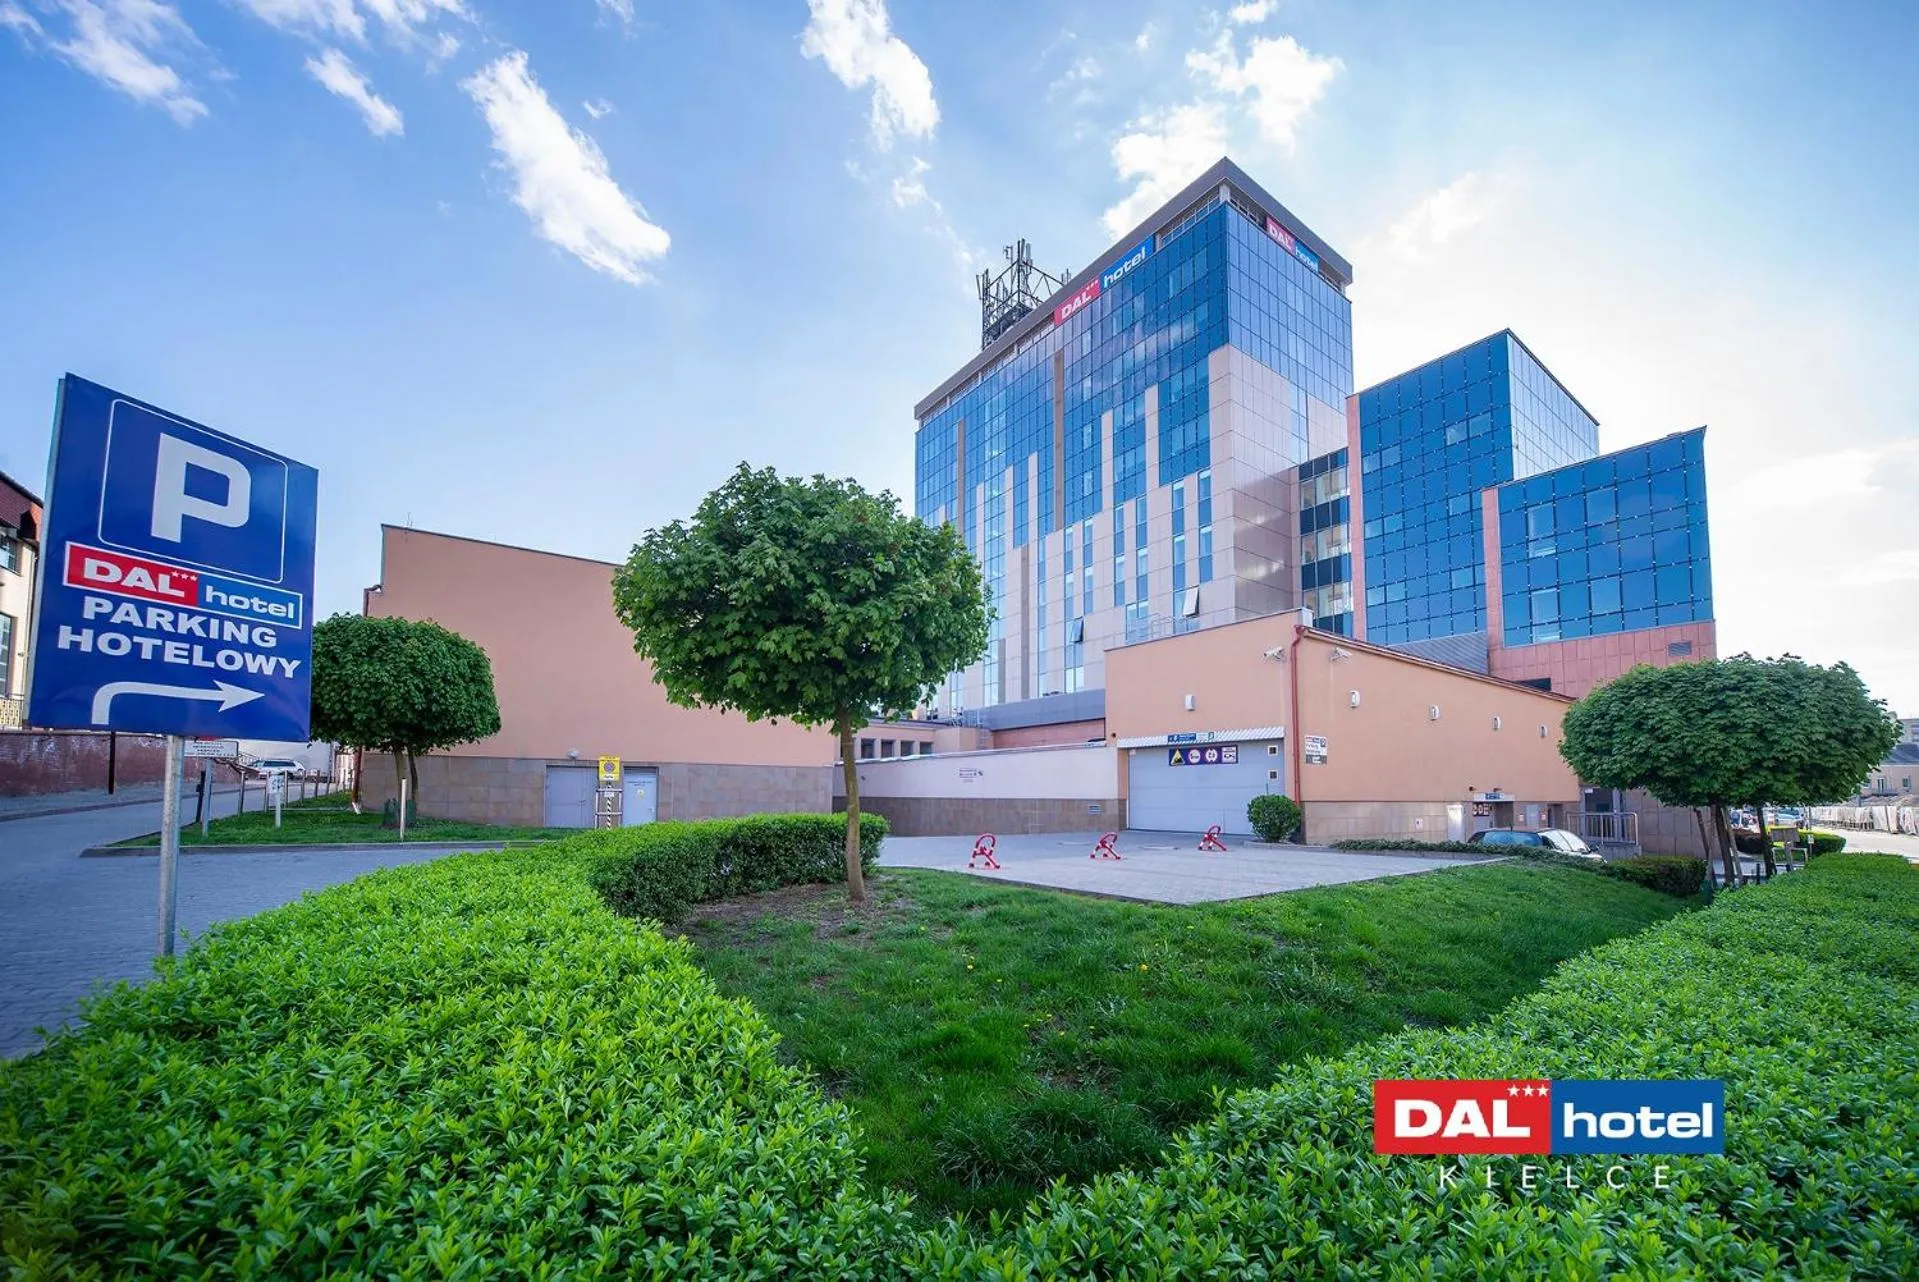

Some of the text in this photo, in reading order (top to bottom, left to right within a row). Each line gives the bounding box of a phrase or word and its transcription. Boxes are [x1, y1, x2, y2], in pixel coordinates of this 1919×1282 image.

[1061, 246, 1146, 320] DAL hotel
[151, 432, 251, 543] P
[83, 557, 295, 619] DAL hotel
[57, 625, 302, 679] HOTELOWY
[82, 596, 278, 649] PARKING
